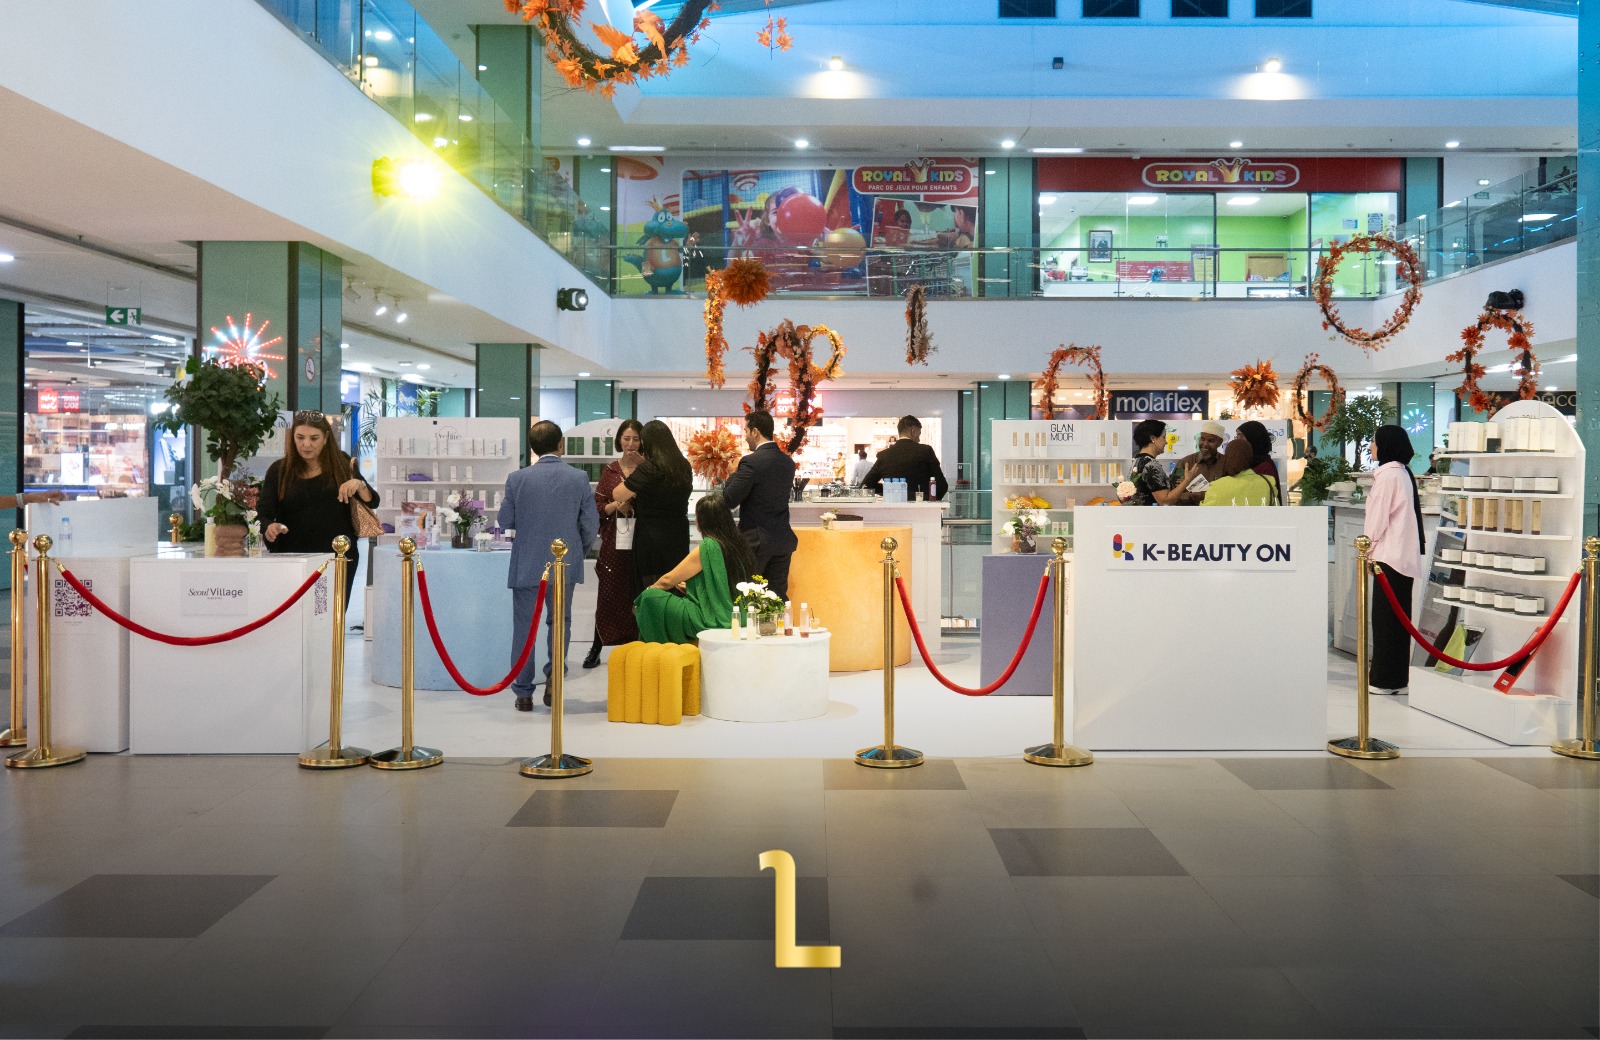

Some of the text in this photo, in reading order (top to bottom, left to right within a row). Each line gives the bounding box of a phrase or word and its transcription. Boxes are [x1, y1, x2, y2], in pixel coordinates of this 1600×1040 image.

[862, 170, 964, 182] ROYAL KIDS
[1155, 170, 1287, 182] ROYAL KIDS
[1116, 392, 1202, 412] molaflex
[1050, 432, 1074, 441] MOOR
[1142, 543, 1253, 562] K-BEAUTY
[1255, 543, 1291, 562] ON
[209, 587, 243, 599] Village
